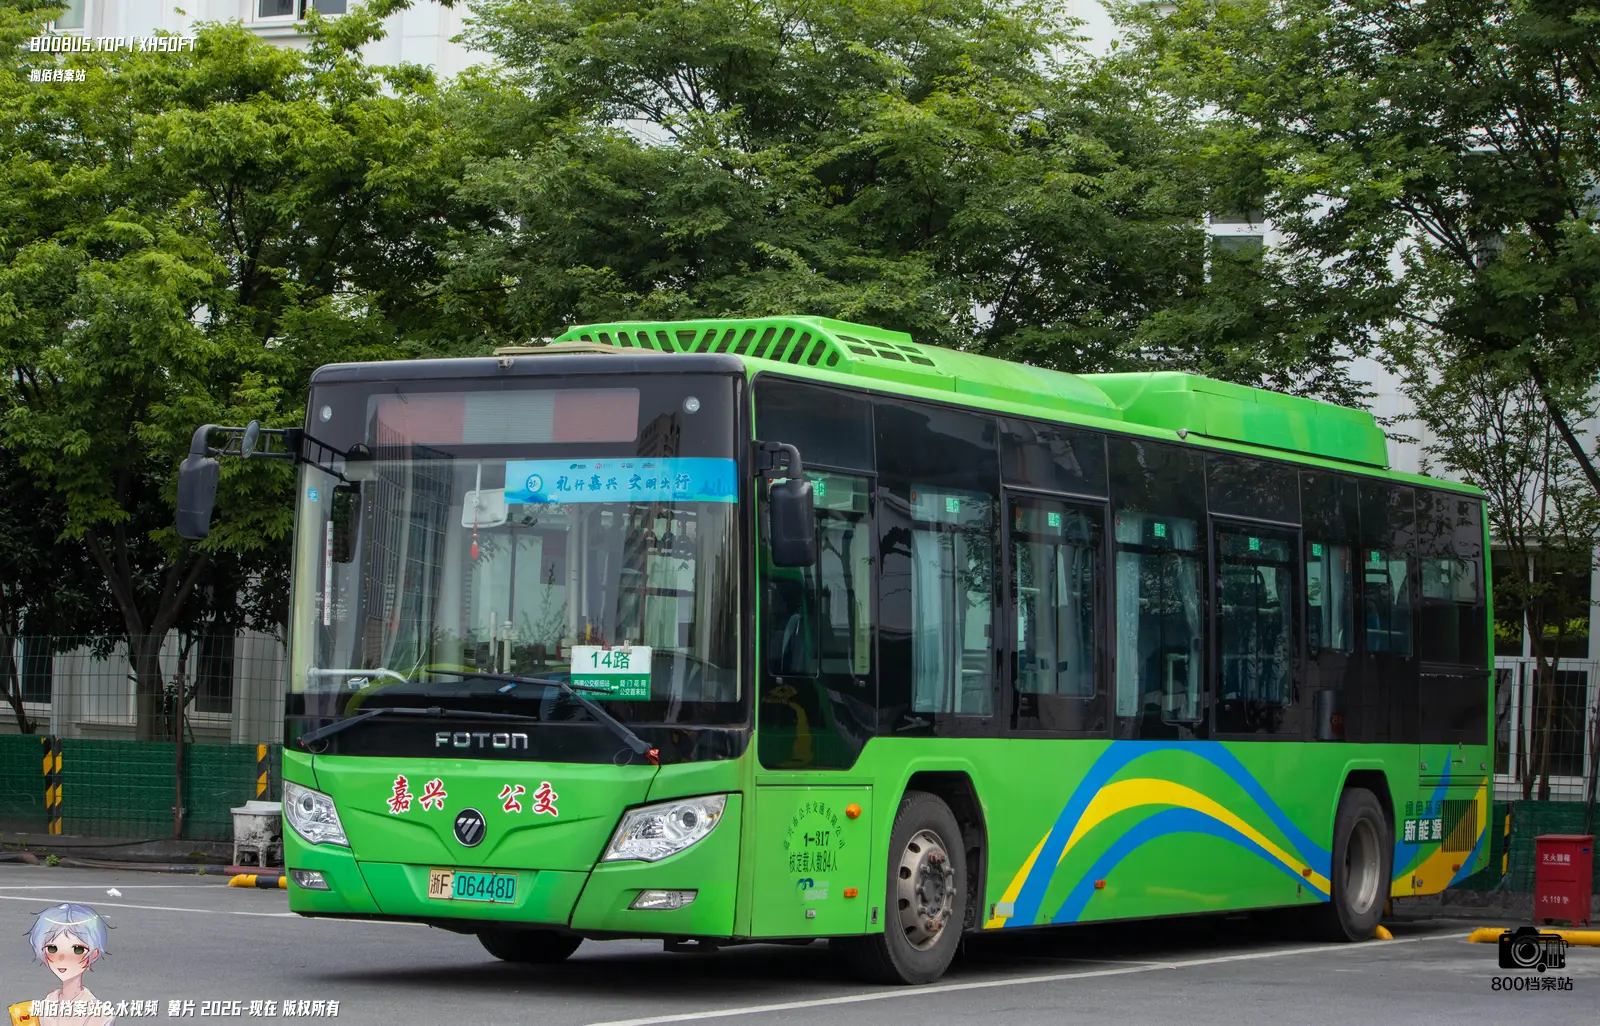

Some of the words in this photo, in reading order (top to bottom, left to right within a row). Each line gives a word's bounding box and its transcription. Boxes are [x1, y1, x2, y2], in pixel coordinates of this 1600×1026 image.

[556, 474, 618, 492] 礼行嘉兴
[627, 473, 692, 491] 文明出行
[590, 651, 630, 669] 14路
[435, 731, 529, 750] FOTON
[387, 774, 448, 815] 嘉兴
[498, 781, 559, 818] 公交
[803, 830, 830, 847] 1-317
[1404, 818, 1443, 841] 新能源
[789, 850, 838, 873] 核定载人数84人
[1542, 853, 1571, 862] 灭火器箱
[430, 873, 450, 895] 浙F
[457, 875, 515, 899] 06448D
[1550, 895, 1561, 904] 119
